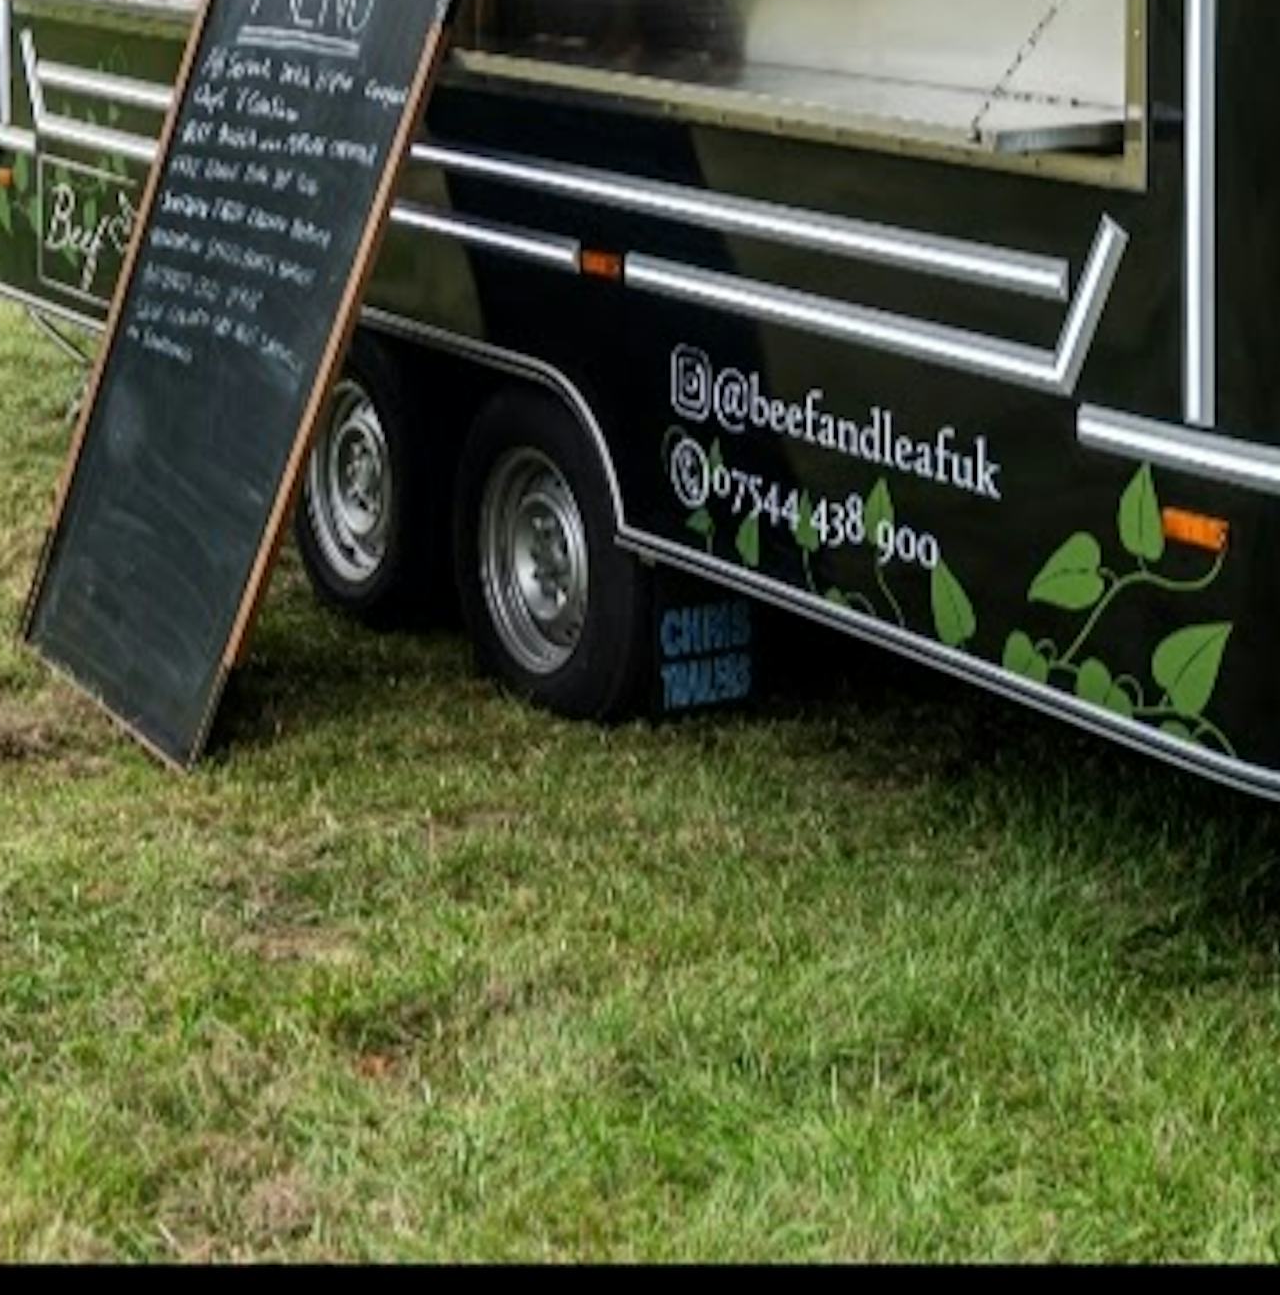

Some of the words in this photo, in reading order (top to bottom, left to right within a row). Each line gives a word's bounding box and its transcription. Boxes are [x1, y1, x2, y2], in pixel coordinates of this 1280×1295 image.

[44, 182, 110, 292] Beef
[713, 367, 1003, 501] @beefandleafuk
[712, 463, 800, 532] 07544
[809, 491, 866, 546] 438
[875, 520, 939, 571] 900
